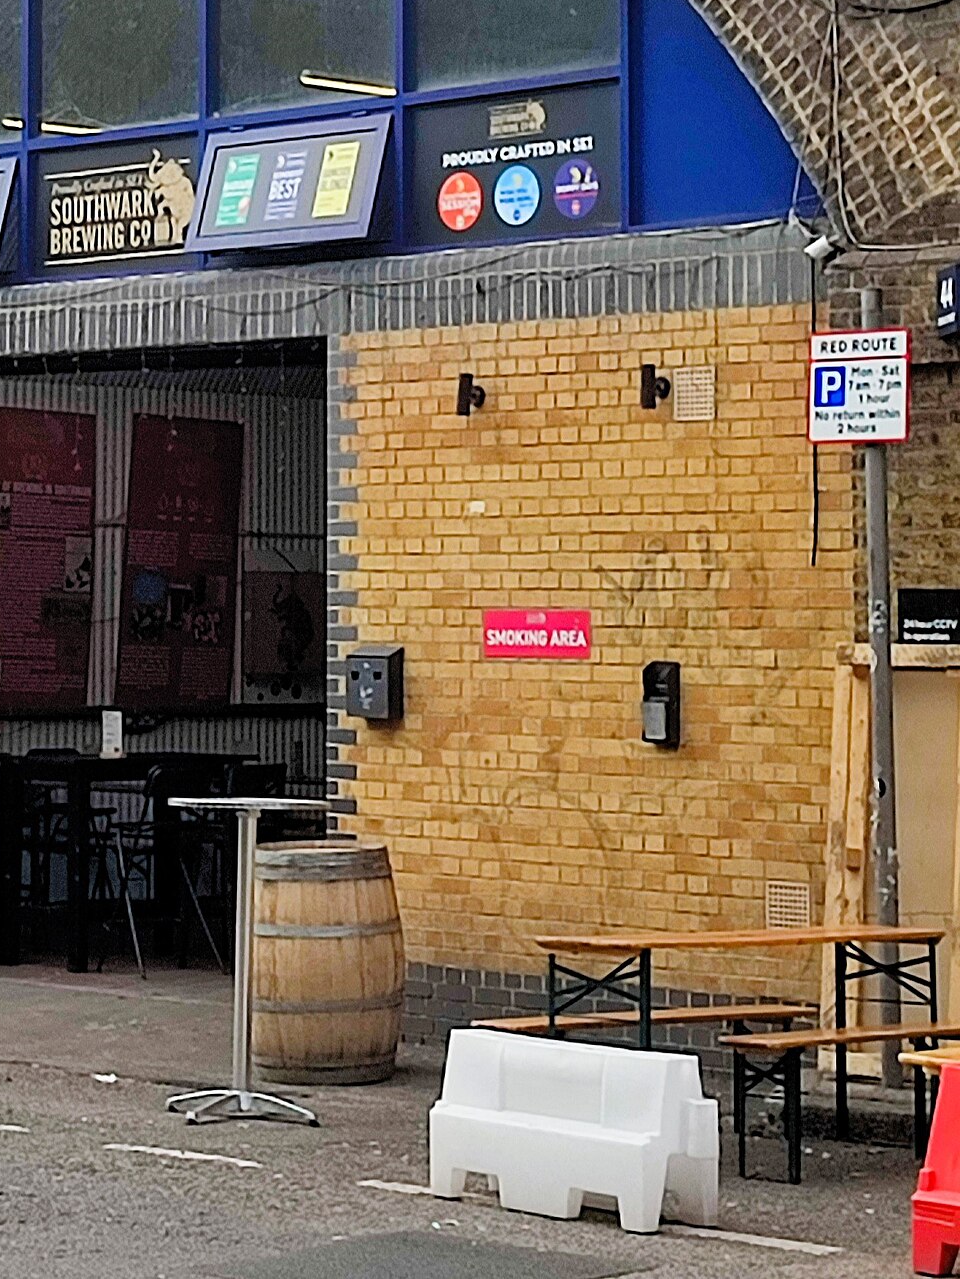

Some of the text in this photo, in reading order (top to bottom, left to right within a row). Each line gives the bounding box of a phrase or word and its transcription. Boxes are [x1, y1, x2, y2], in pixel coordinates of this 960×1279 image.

[442, 146, 499, 168] PROUDLY
[500, 140, 555, 162] CRAFTED
[557, 140, 571, 153] IN
[268, 177, 302, 201] BEST
[50, 188, 156, 227] SOUTHWARK
[50, 221, 125, 255] BREWING
[820, 337, 897, 354] RED ROUTE
[851, 364, 900, 377] Mon Sat
[820, 370, 842, 404] P
[867, 393, 890, 404] hour
[814, 407, 901, 421] No return within
[837, 422, 876, 434] 2 hours
[933, 618, 959, 630] CCTV
[486, 628, 587, 648] SMOKING AREA
